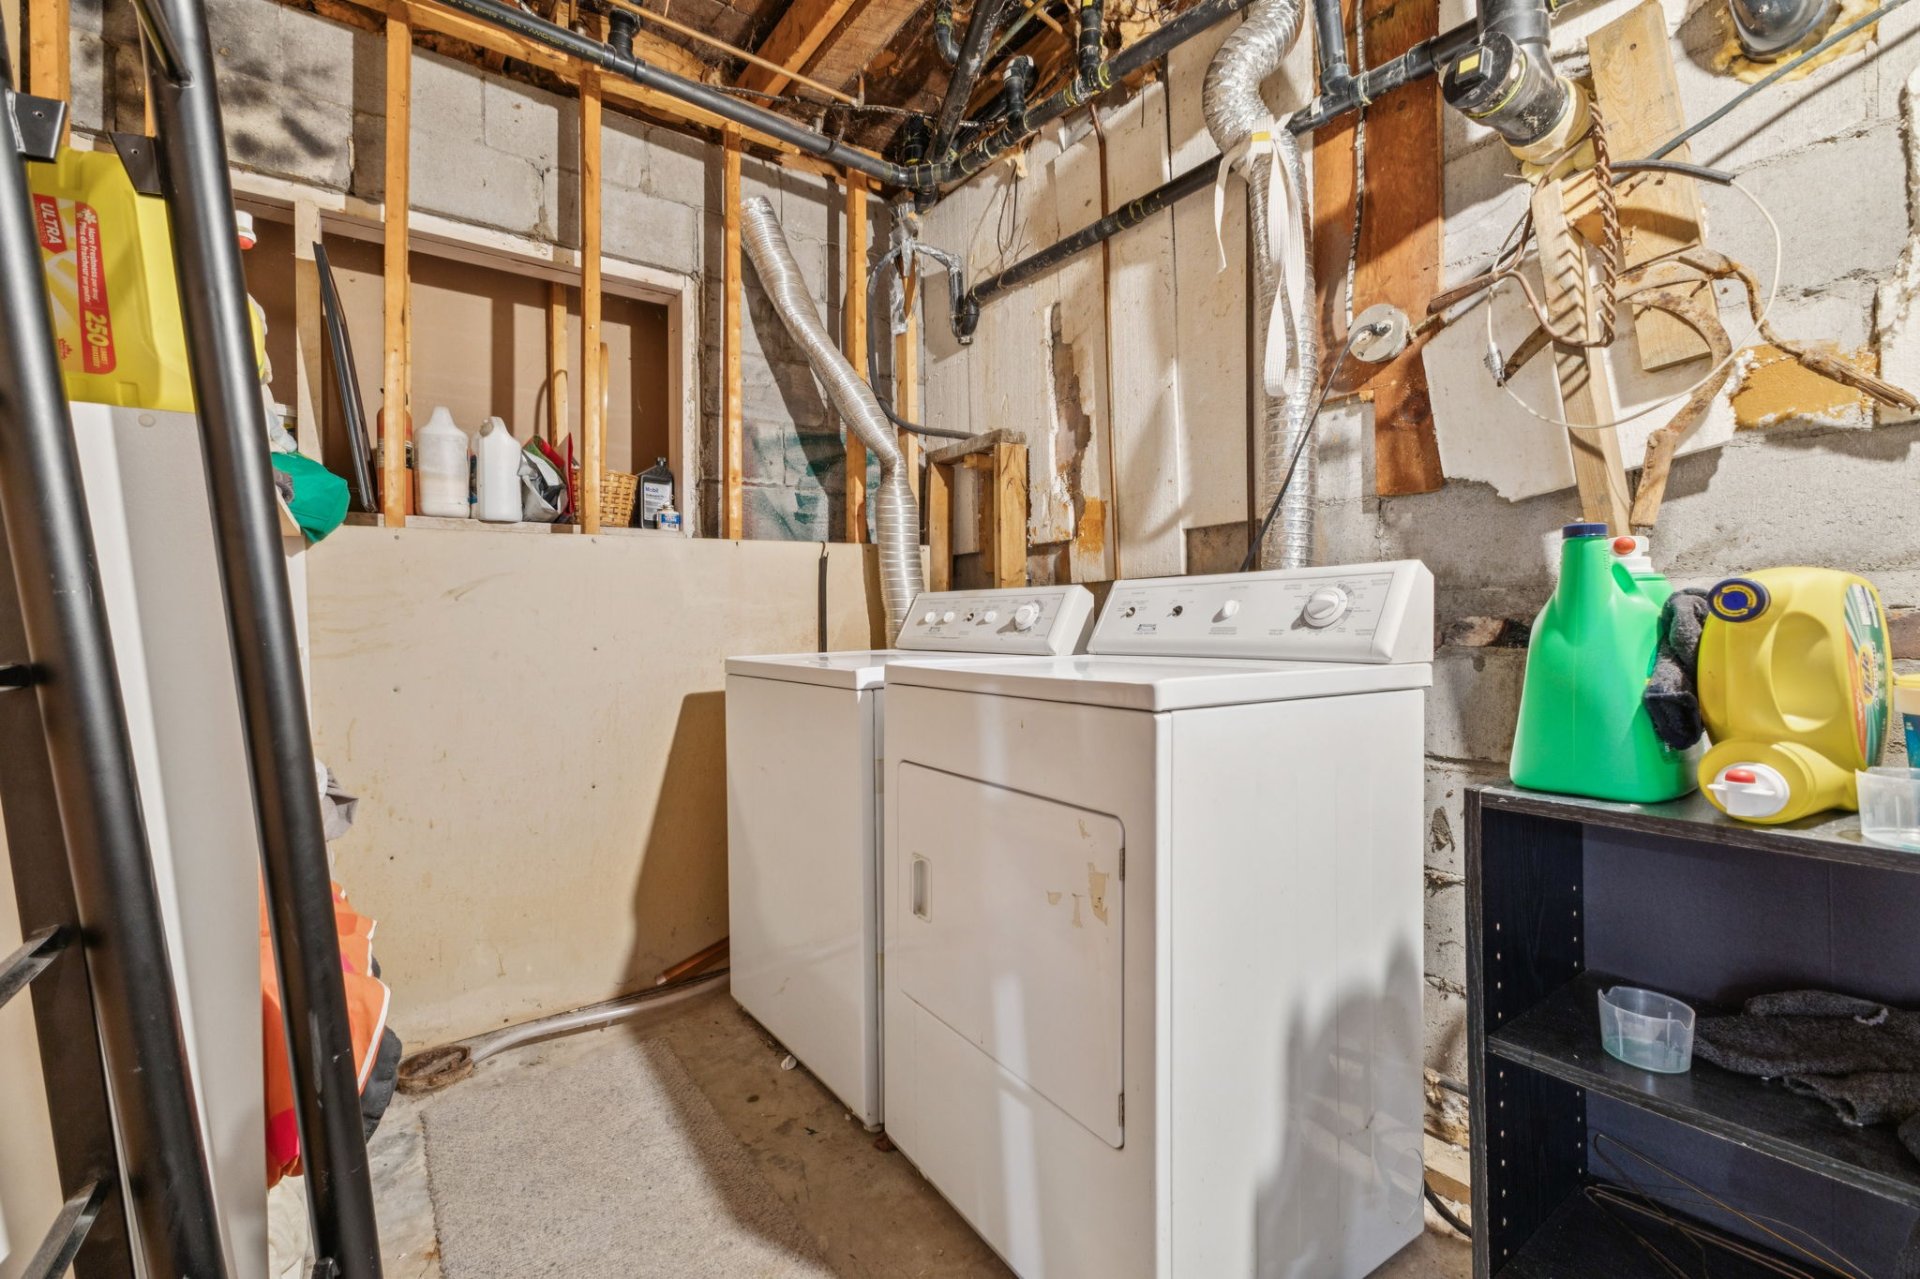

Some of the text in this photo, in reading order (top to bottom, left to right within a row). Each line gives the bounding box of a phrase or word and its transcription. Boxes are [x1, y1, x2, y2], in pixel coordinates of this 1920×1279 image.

[40, 202, 62, 244] ULTRA
[89, 245, 98, 278] Freshness
[85, 311, 109, 346] 250
